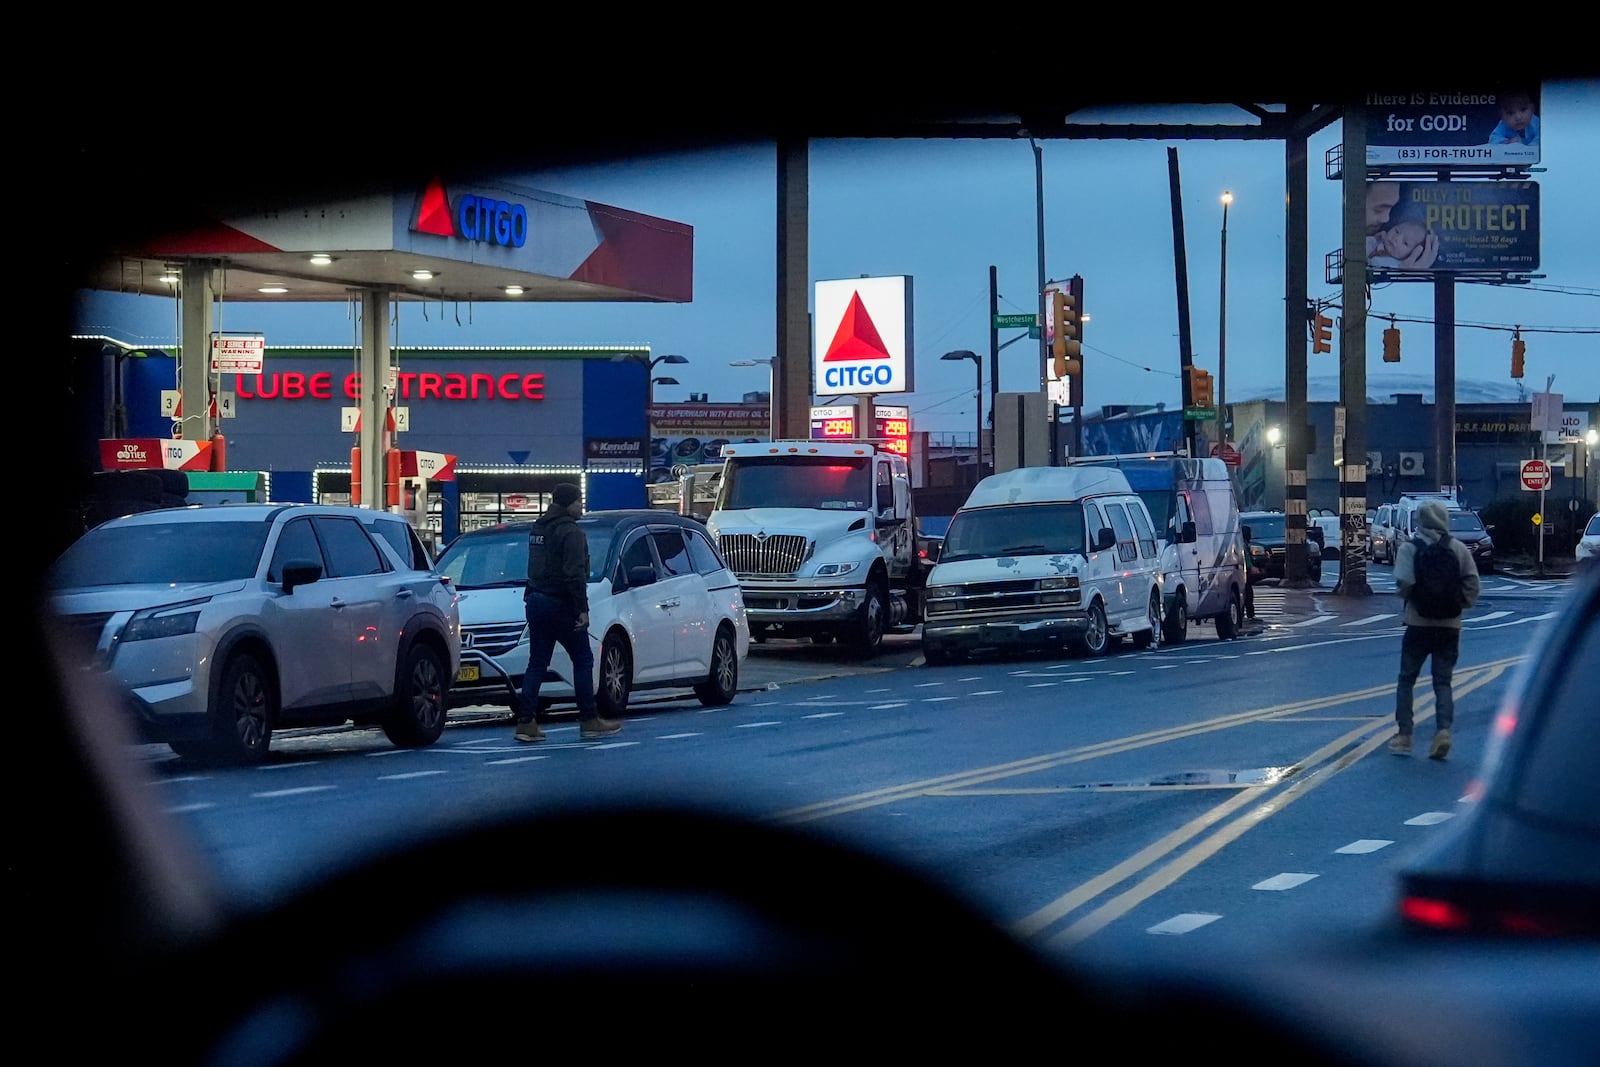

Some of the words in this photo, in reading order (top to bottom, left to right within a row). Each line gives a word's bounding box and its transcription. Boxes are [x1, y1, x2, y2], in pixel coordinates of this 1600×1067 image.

[1365, 91, 1406, 105] There
[1410, 91, 1426, 105] IS
[1429, 91, 1496, 105] Evidence
[1386, 113, 1415, 132] for
[1419, 114, 1468, 132] GOD!
[1397, 148, 1421, 159] (83)
[1424, 148, 1492, 159] FOR-TRUTH
[1412, 188, 1452, 202] DUTY
[1455, 188, 1472, 202] TO
[458, 193, 528, 248] CITGO
[1426, 204, 1530, 231] PROTECT
[825, 365, 892, 387] CITGO
[234, 372, 332, 399] LUBE
[166, 398, 172, 409] 3
[223, 399, 229, 410] 4
[709, 410, 727, 418] WITH
[727, 410, 750, 418] EVERY
[751, 410, 762, 418] OIL
[813, 409, 833, 417] CITGO
[347, 415, 352, 425] 1
[399, 414, 405, 425] 2
[1562, 416, 1580, 426] uto
[1481, 423, 1506, 432] AUTO
[1508, 423, 1532, 432] PART
[1558, 427, 1580, 437] Plus
[123, 444, 139, 452] TOP
[599, 441, 641, 451] Kendall
[130, 451, 146, 459] TIER
[420, 459, 435, 469] CITGO
[529, 535, 545, 545] POLICE
